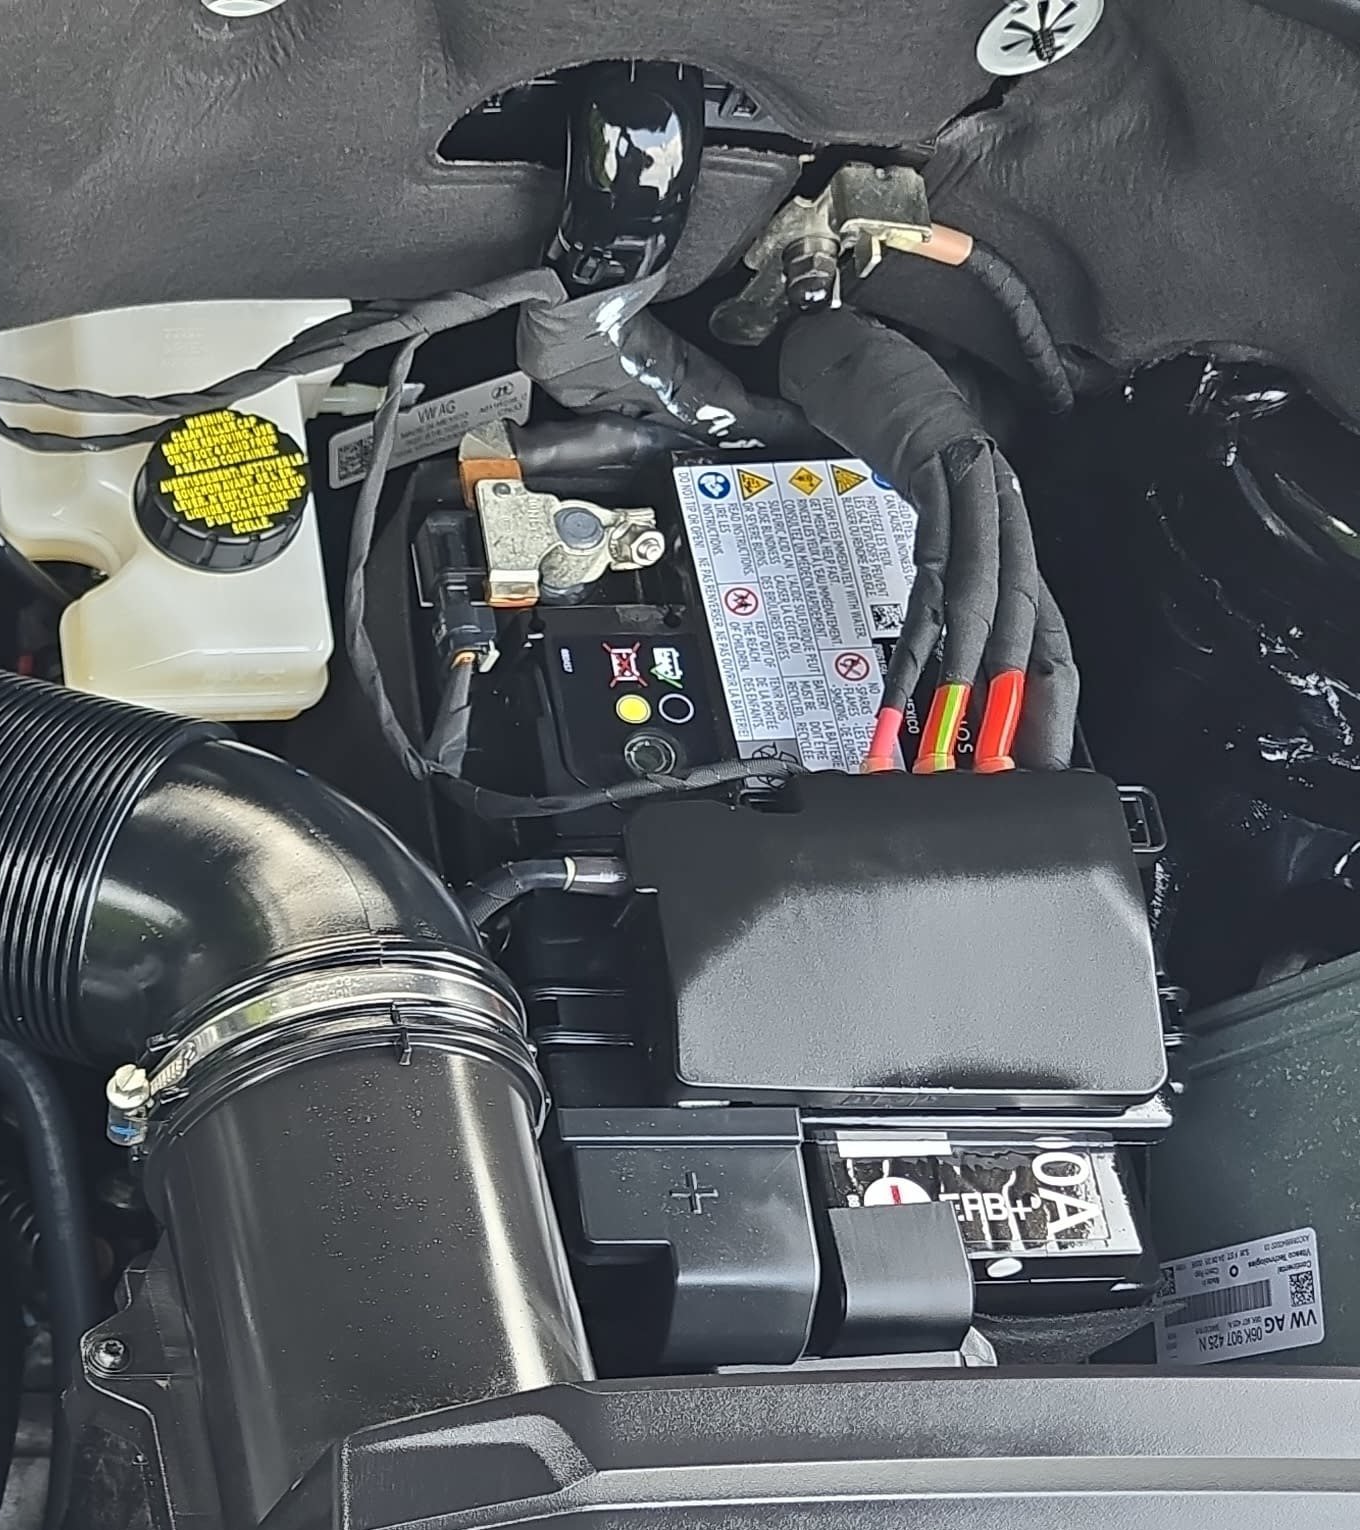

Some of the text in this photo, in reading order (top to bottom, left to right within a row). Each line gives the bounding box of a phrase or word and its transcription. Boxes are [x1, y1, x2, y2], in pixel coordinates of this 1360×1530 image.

[416, 404, 437, 423] VW
[434, 398, 457, 417] AG
[161, 438, 200, 456] BEFORE
[252, 422, 273, 435] USE
[170, 415, 256, 443] CLEAN FILLER CAP
[175, 464, 182, 475] A
[182, 456, 219, 473] SEALED
[239, 456, 289, 476] NETTOYER
[289, 452, 303, 465] LE
[905, 698, 920, 734] EXICO
[1261, 1314, 1287, 1334] AG
[1288, 1308, 1317, 1329] VW
[1197, 1336, 1208, 1352] N
[1206, 1332, 1226, 1350] 425
[1224, 1329, 1243, 1347] 907
[1242, 1325, 1264, 1343] 06K
